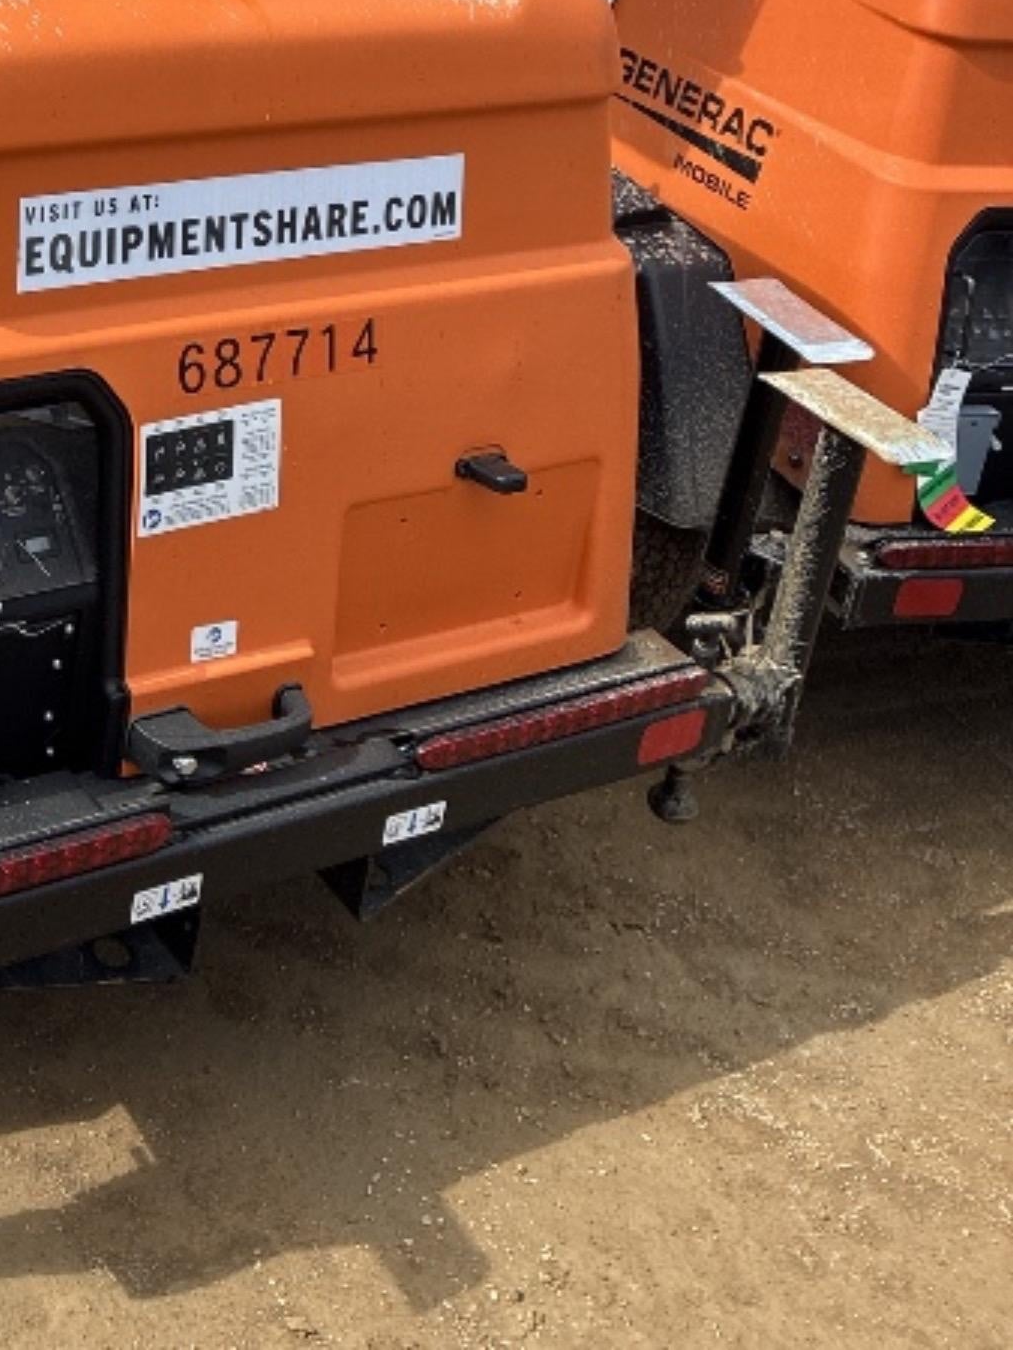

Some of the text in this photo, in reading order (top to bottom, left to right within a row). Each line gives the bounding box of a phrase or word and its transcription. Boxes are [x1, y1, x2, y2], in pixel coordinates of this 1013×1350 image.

[24, 193, 160, 226] VISIT US AT:
[672, 152, 752, 211] MOBILE
[24, 190, 457, 277] EQUIPMENTSHARE.COM
[177, 317, 379, 395] 687714
